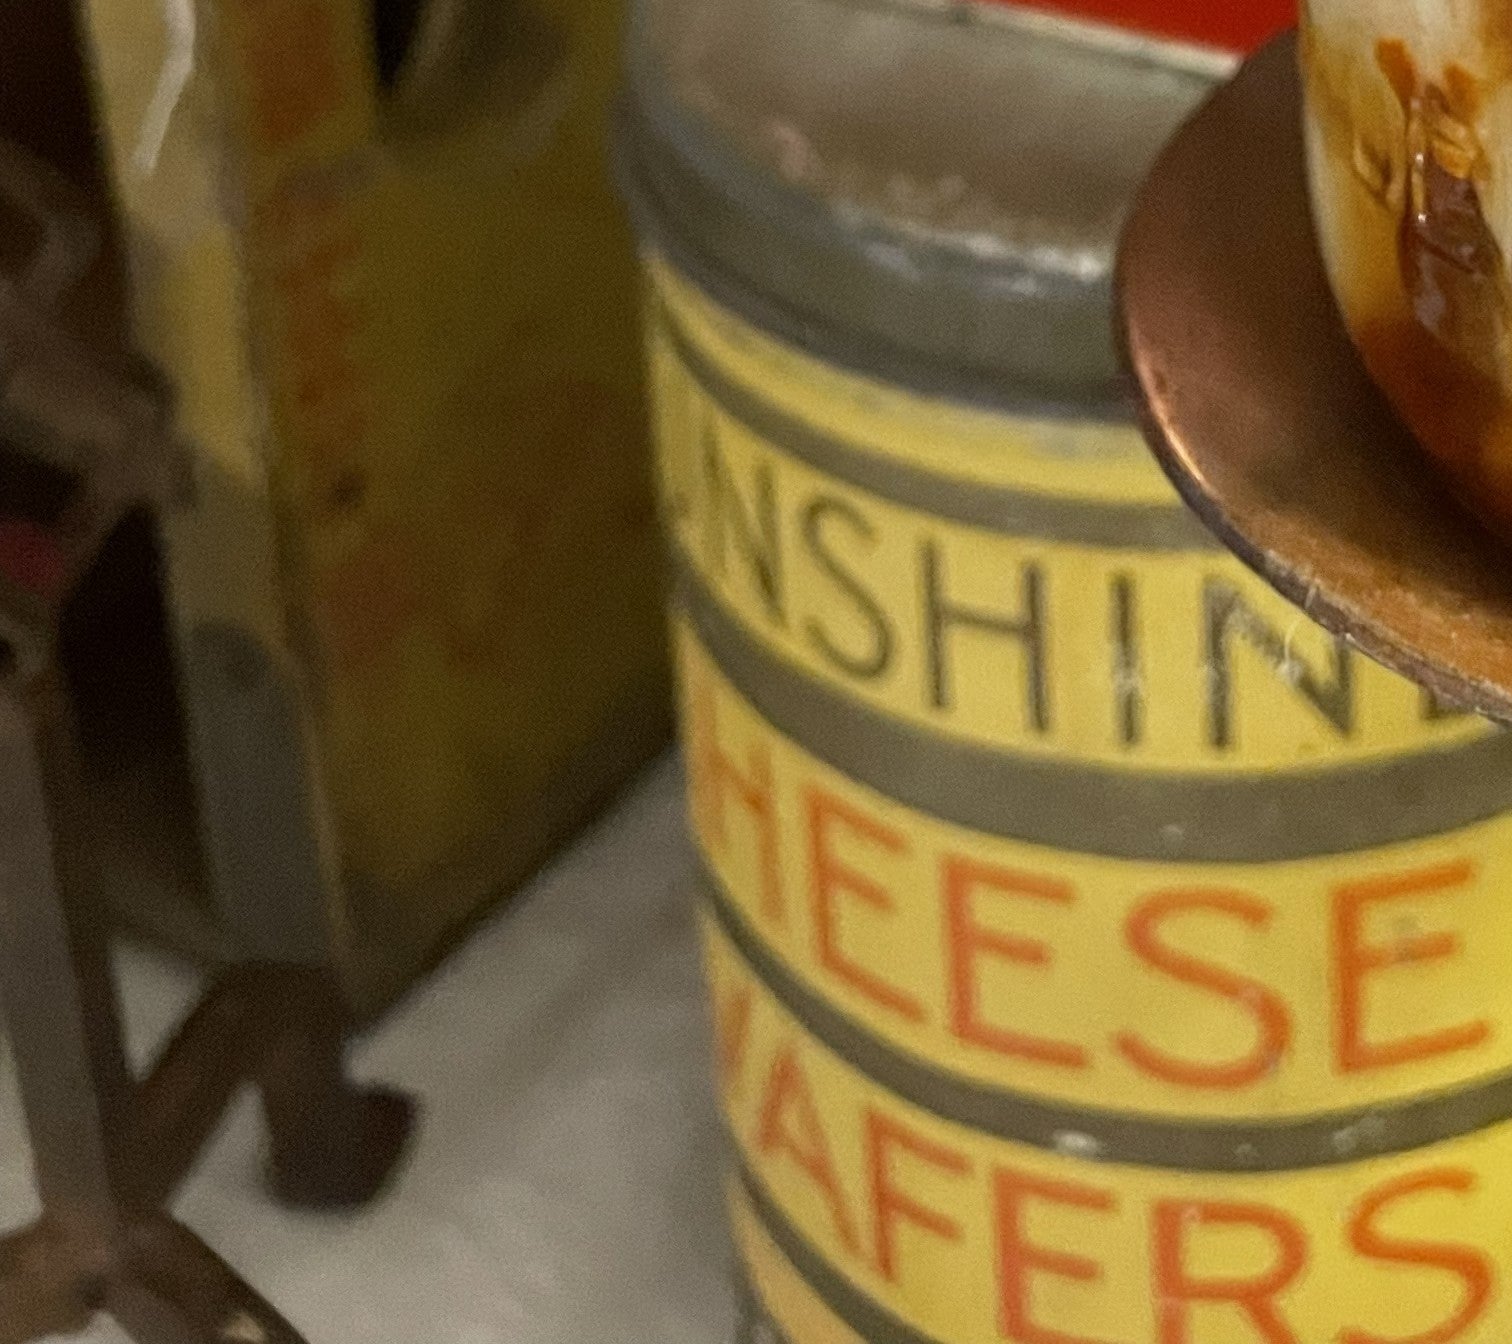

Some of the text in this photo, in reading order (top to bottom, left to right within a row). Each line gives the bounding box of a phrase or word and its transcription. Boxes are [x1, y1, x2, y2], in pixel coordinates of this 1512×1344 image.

[690, 417, 1450, 754] NSHIN
[690, 662, 1493, 1094] HEESE
[715, 980, 1500, 1344] AFERS
